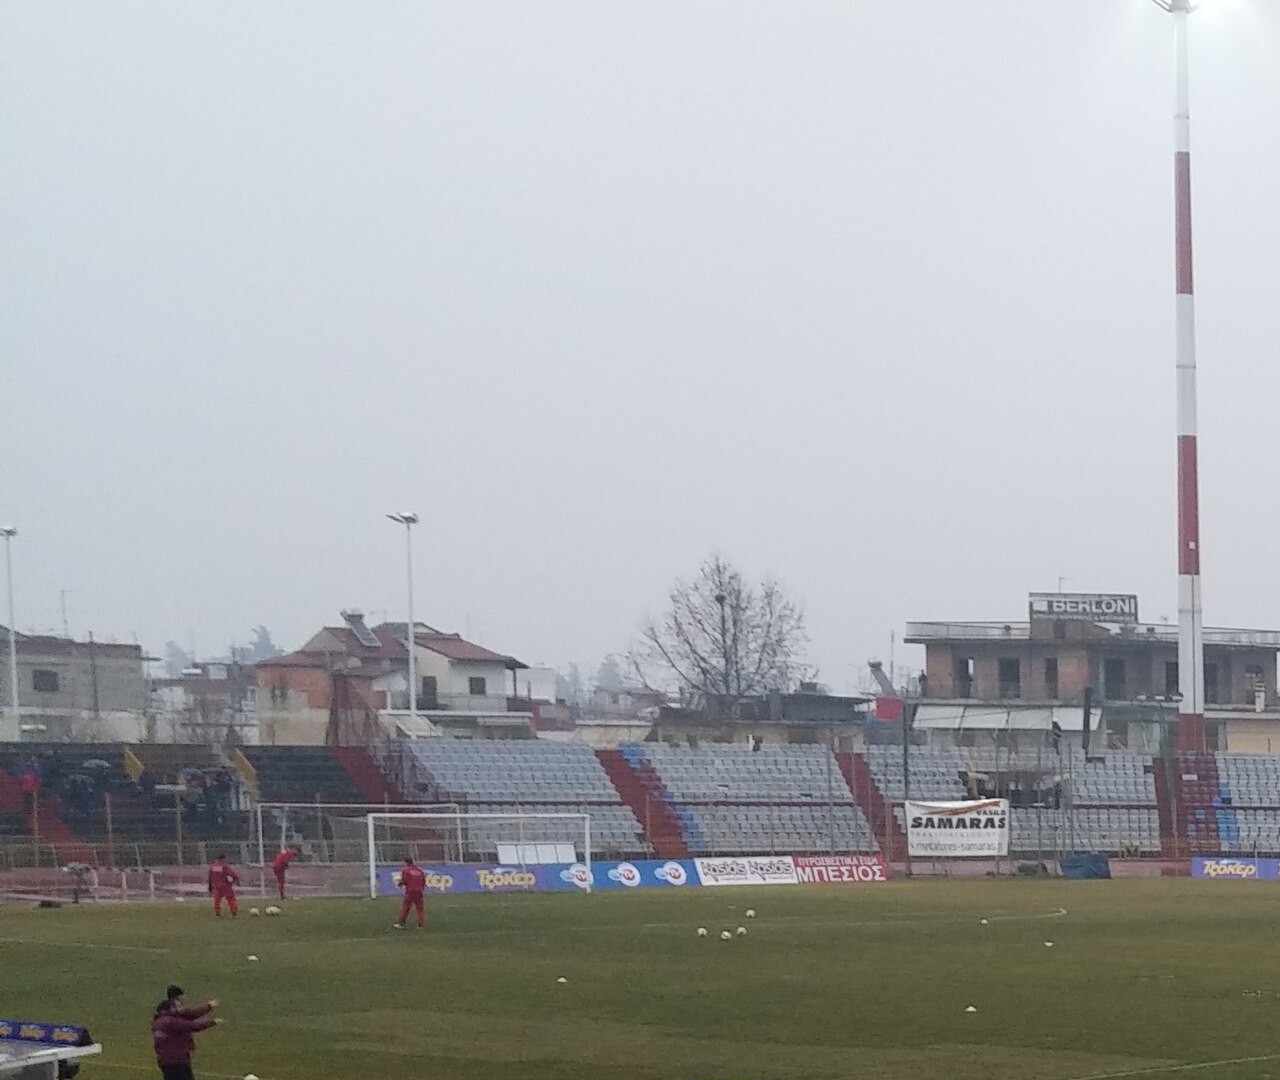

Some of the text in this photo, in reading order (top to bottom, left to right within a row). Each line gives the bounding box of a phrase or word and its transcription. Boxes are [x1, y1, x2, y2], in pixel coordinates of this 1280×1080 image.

[1053, 597, 1135, 613] BERLONI
[910, 816, 1006, 829] SAMARAS
[796, 865, 887, 883] ΜΠΕΣΙΟΣ
